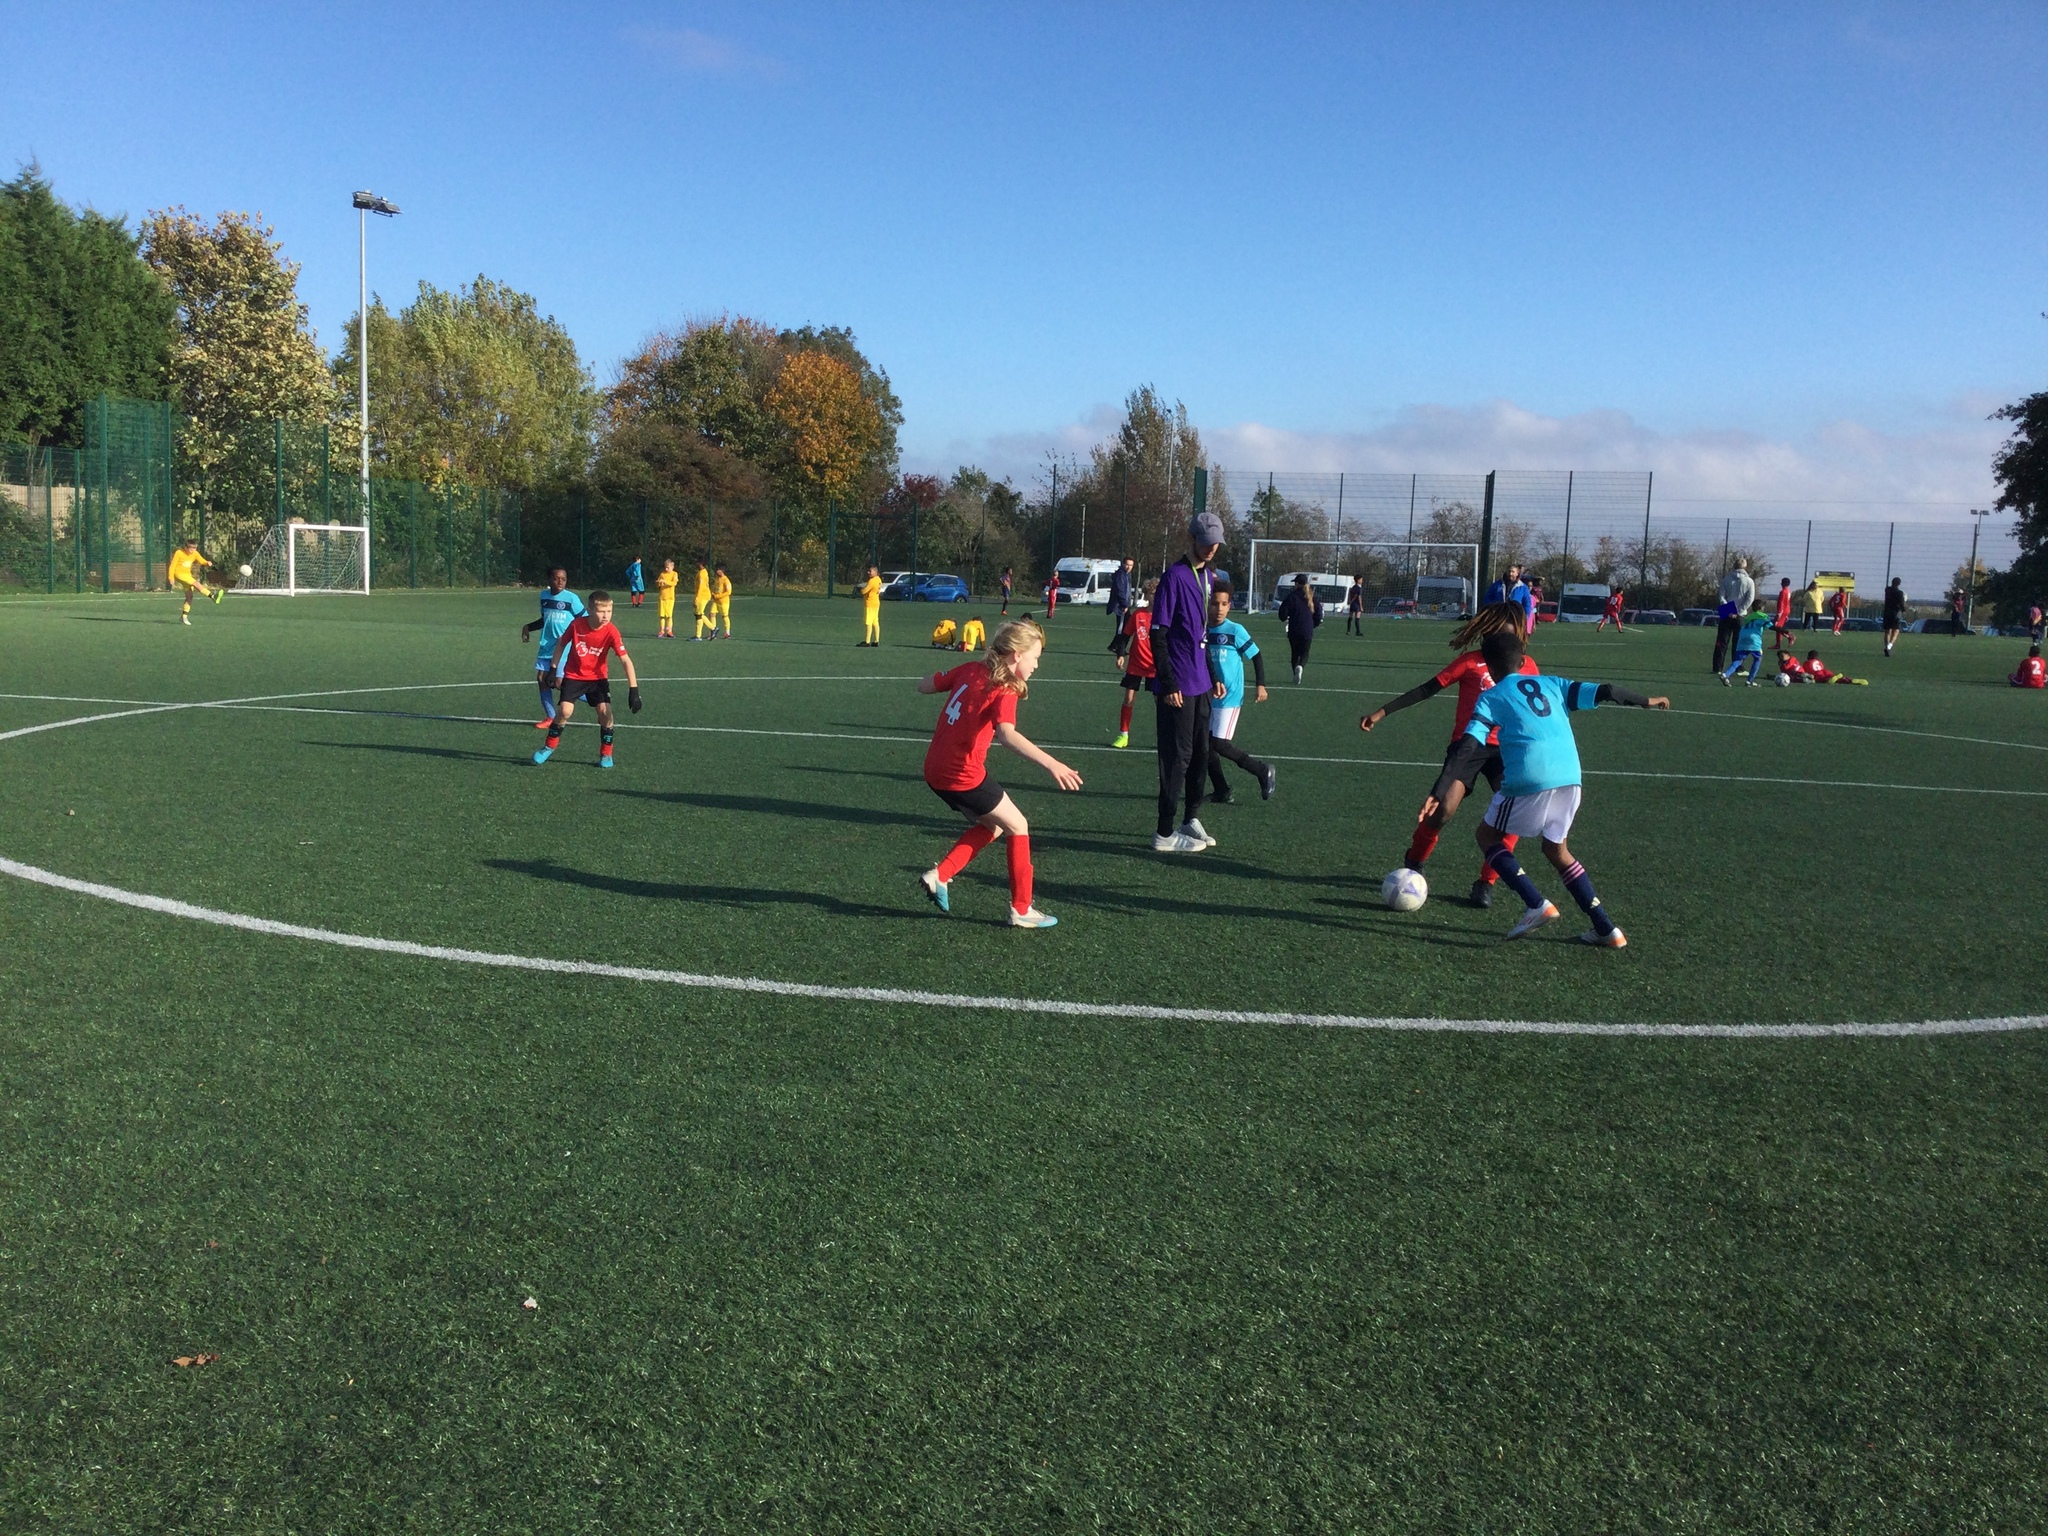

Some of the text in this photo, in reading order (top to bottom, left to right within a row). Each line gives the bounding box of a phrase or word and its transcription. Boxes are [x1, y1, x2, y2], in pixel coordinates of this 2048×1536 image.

[1812, 660, 1823, 672] 6
[2031, 660, 2042, 675] 2
[945, 684, 968, 725] 4
[1517, 678, 1551, 718] 8
